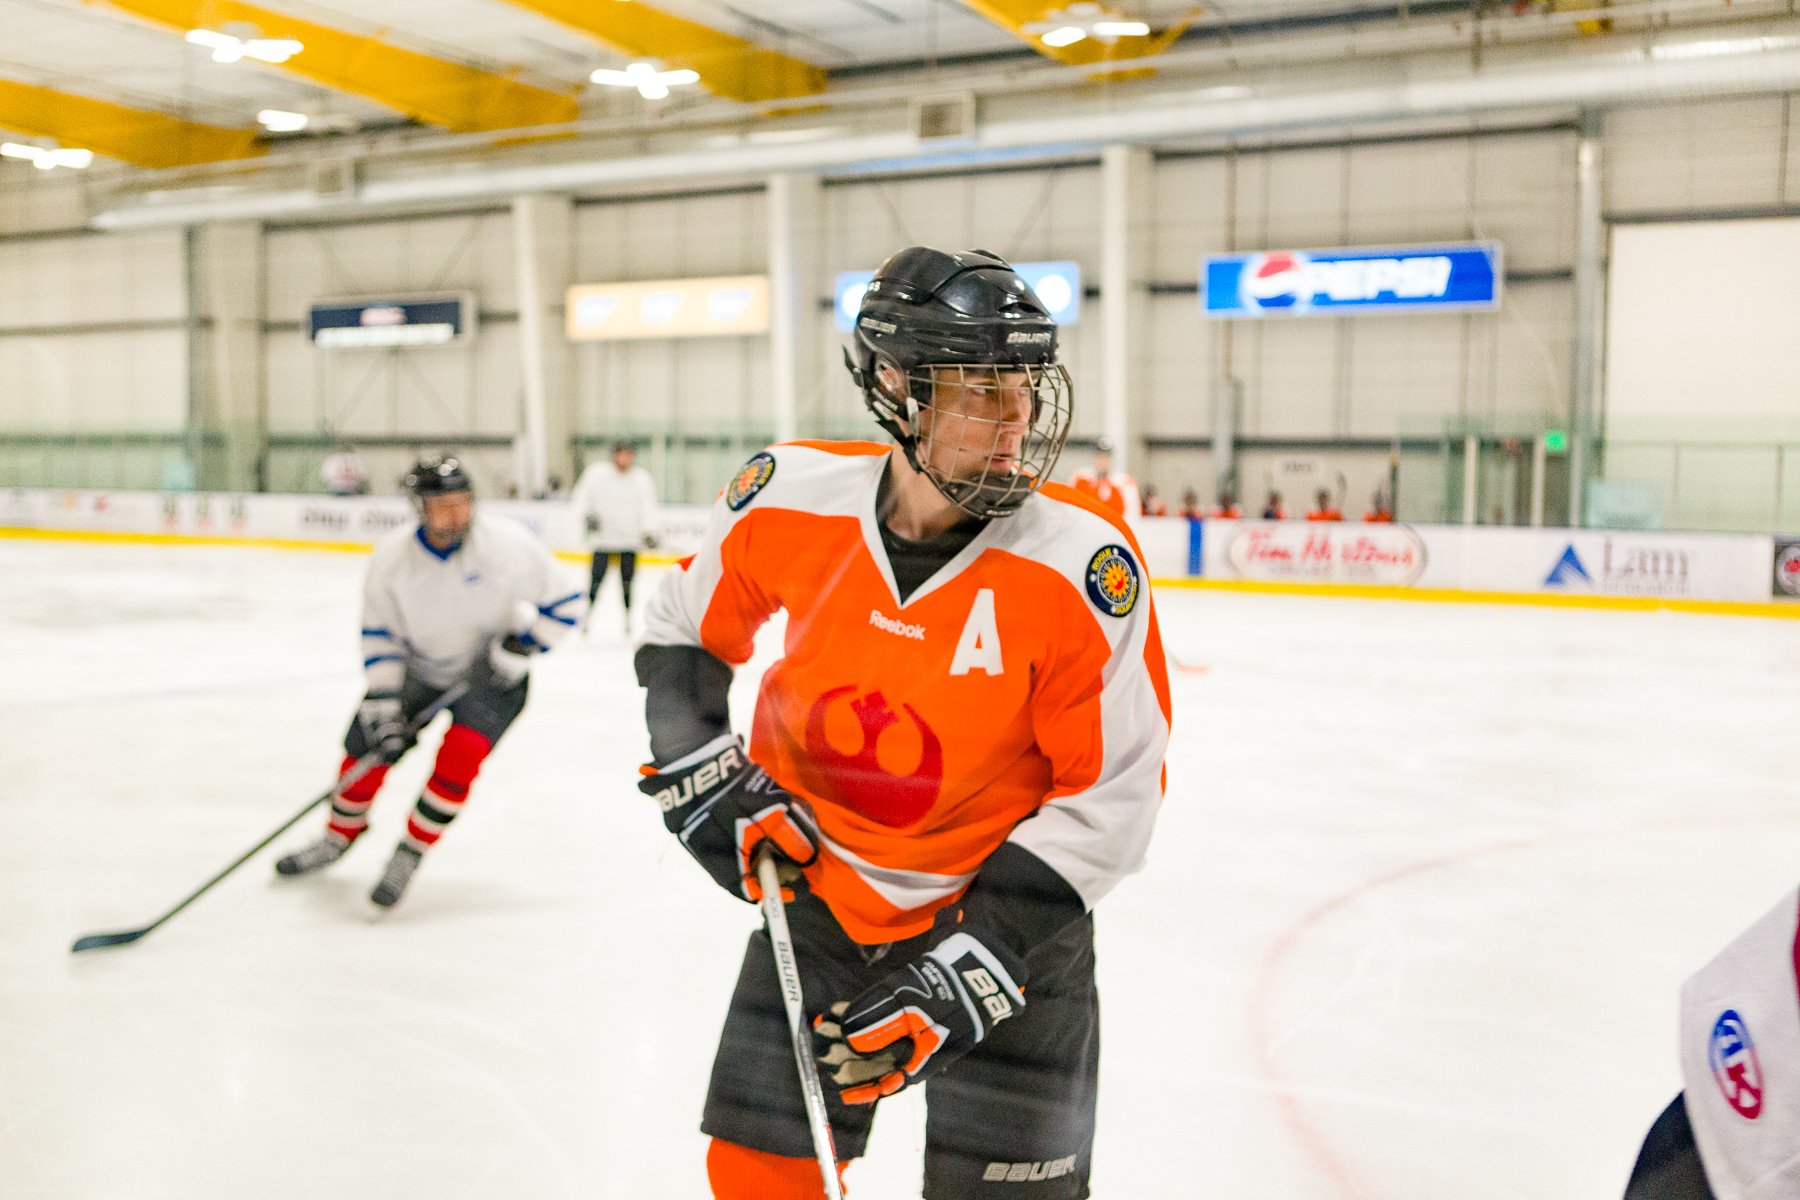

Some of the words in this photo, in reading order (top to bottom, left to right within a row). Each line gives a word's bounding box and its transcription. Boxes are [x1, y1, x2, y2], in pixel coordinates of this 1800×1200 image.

[1302, 257, 1452, 300] PEPSI
[1603, 536, 1690, 577] Lam
[869, 609, 926, 641] Reebok
[949, 588, 1004, 676] A
[654, 747, 743, 813] AUER
[982, 1153, 1077, 1182] BAUER
